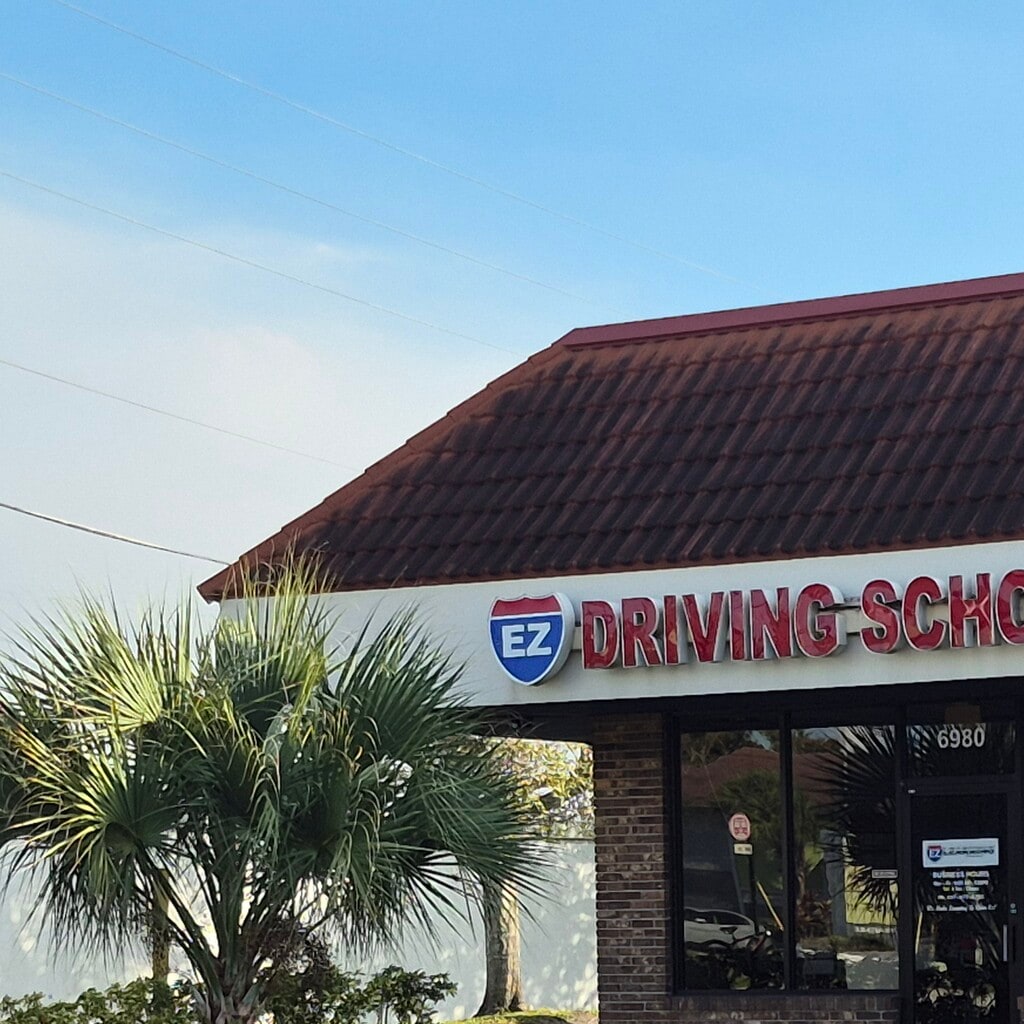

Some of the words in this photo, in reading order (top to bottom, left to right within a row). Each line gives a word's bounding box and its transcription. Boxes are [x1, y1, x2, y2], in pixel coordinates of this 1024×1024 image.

[502, 620, 552, 658] EZ
[581, 582, 846, 669] DRIVING
[937, 727, 986, 749] 6980
